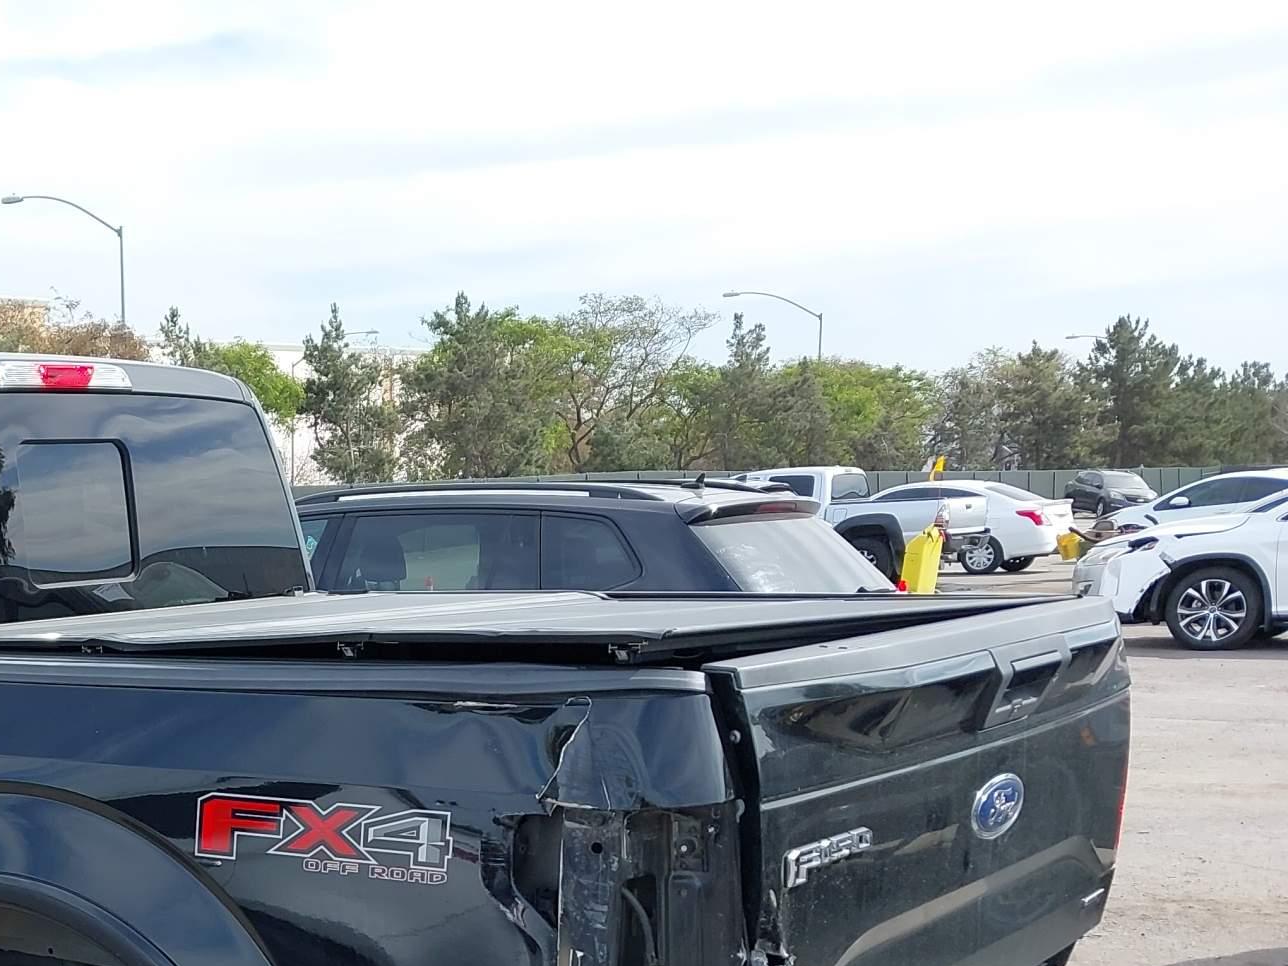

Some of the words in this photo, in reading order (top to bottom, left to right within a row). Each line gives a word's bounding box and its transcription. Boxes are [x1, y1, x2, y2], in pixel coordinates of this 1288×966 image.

[195, 792, 452, 872] FX4
[303, 859, 358, 875] OFF
[368, 865, 448, 885] ROAD
